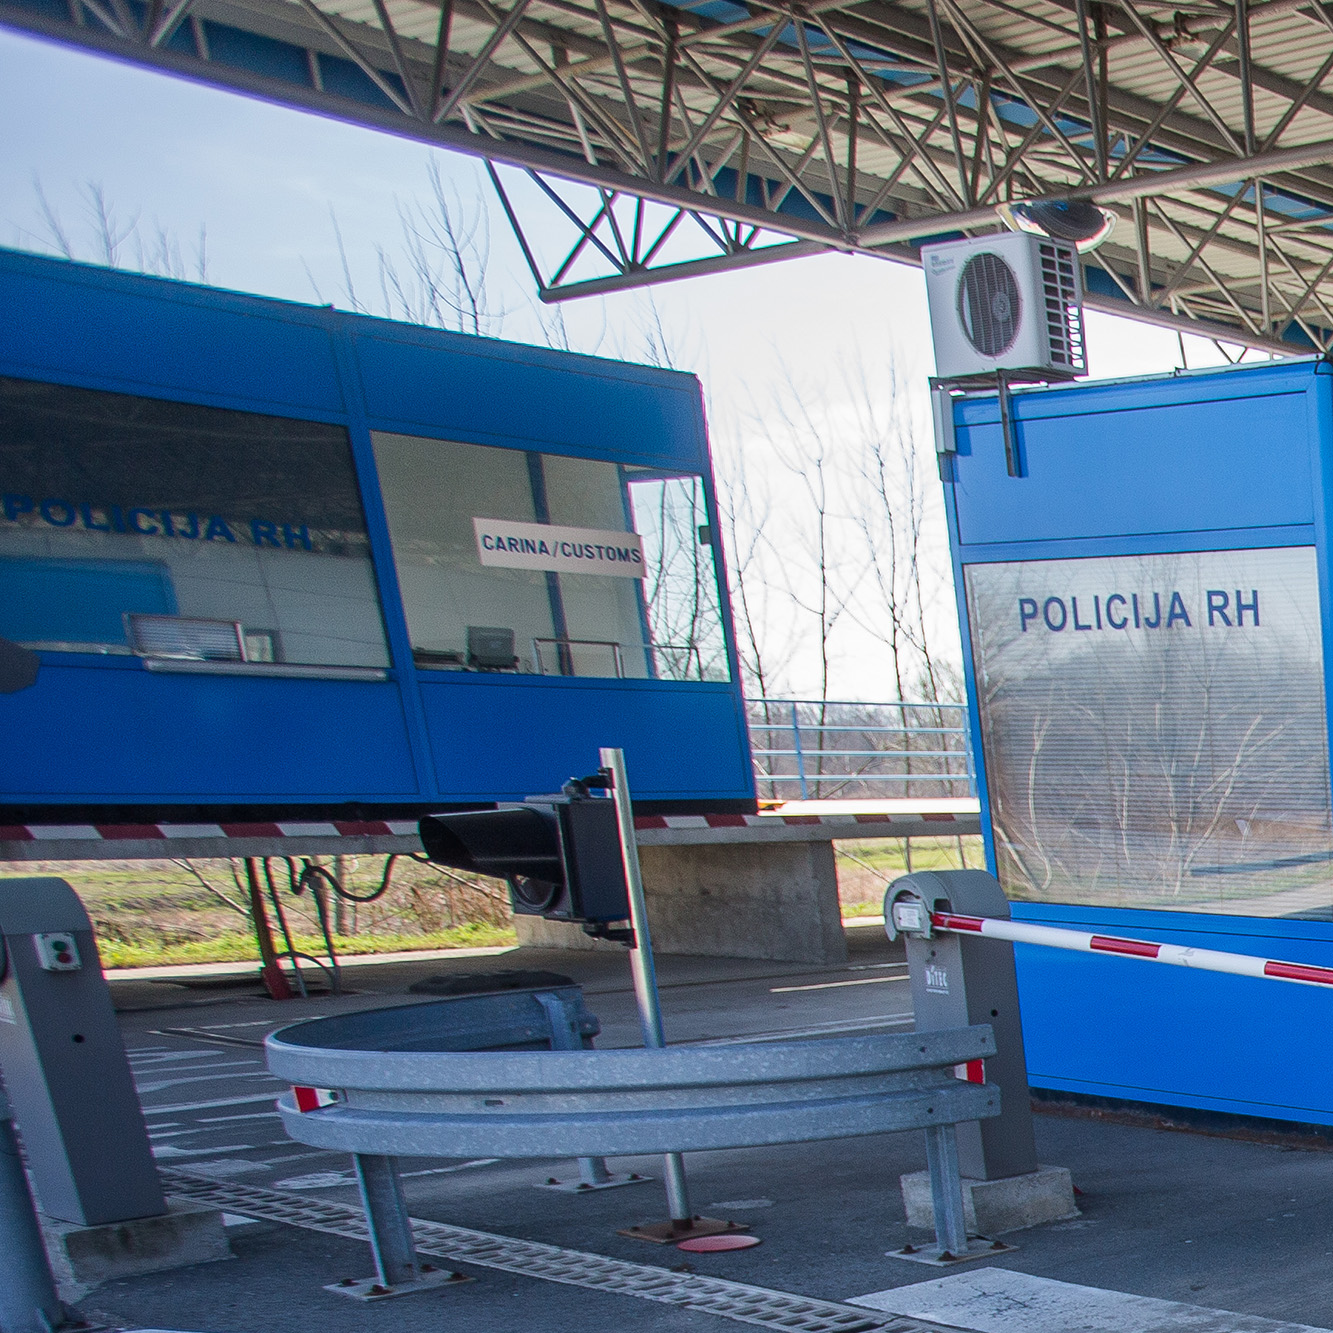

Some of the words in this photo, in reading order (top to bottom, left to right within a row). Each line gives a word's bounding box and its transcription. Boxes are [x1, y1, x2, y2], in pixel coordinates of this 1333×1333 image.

[2, 493, 236, 544] POLICIJA
[250, 519, 313, 551] RH
[482, 534, 642, 564] CARINA/CUSTOMS
[1018, 591, 1193, 632] POLICIJA
[1206, 589, 1261, 627] RH
